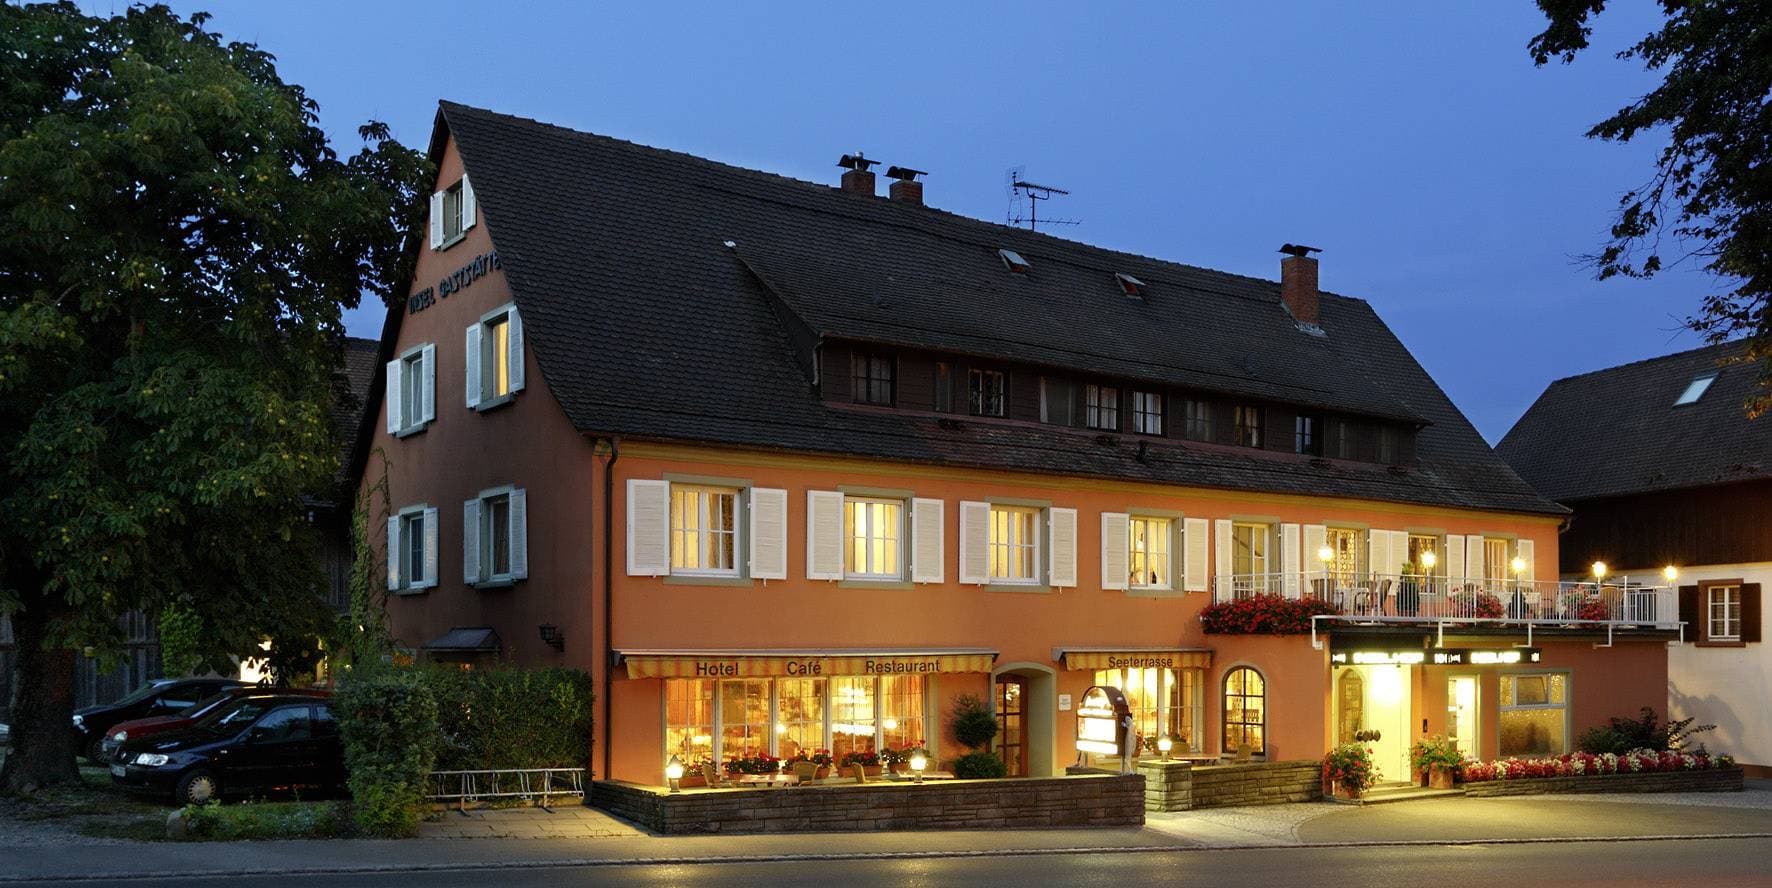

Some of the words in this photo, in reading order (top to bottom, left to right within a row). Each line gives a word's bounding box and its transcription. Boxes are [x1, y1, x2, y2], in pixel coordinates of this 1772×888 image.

[408, 286, 436, 314] INSEL
[696, 661, 739, 676] Hotel
[787, 660, 822, 675] Café
[866, 658, 940, 674] Restaurant
[1108, 656, 1173, 669] Seeterrasse
